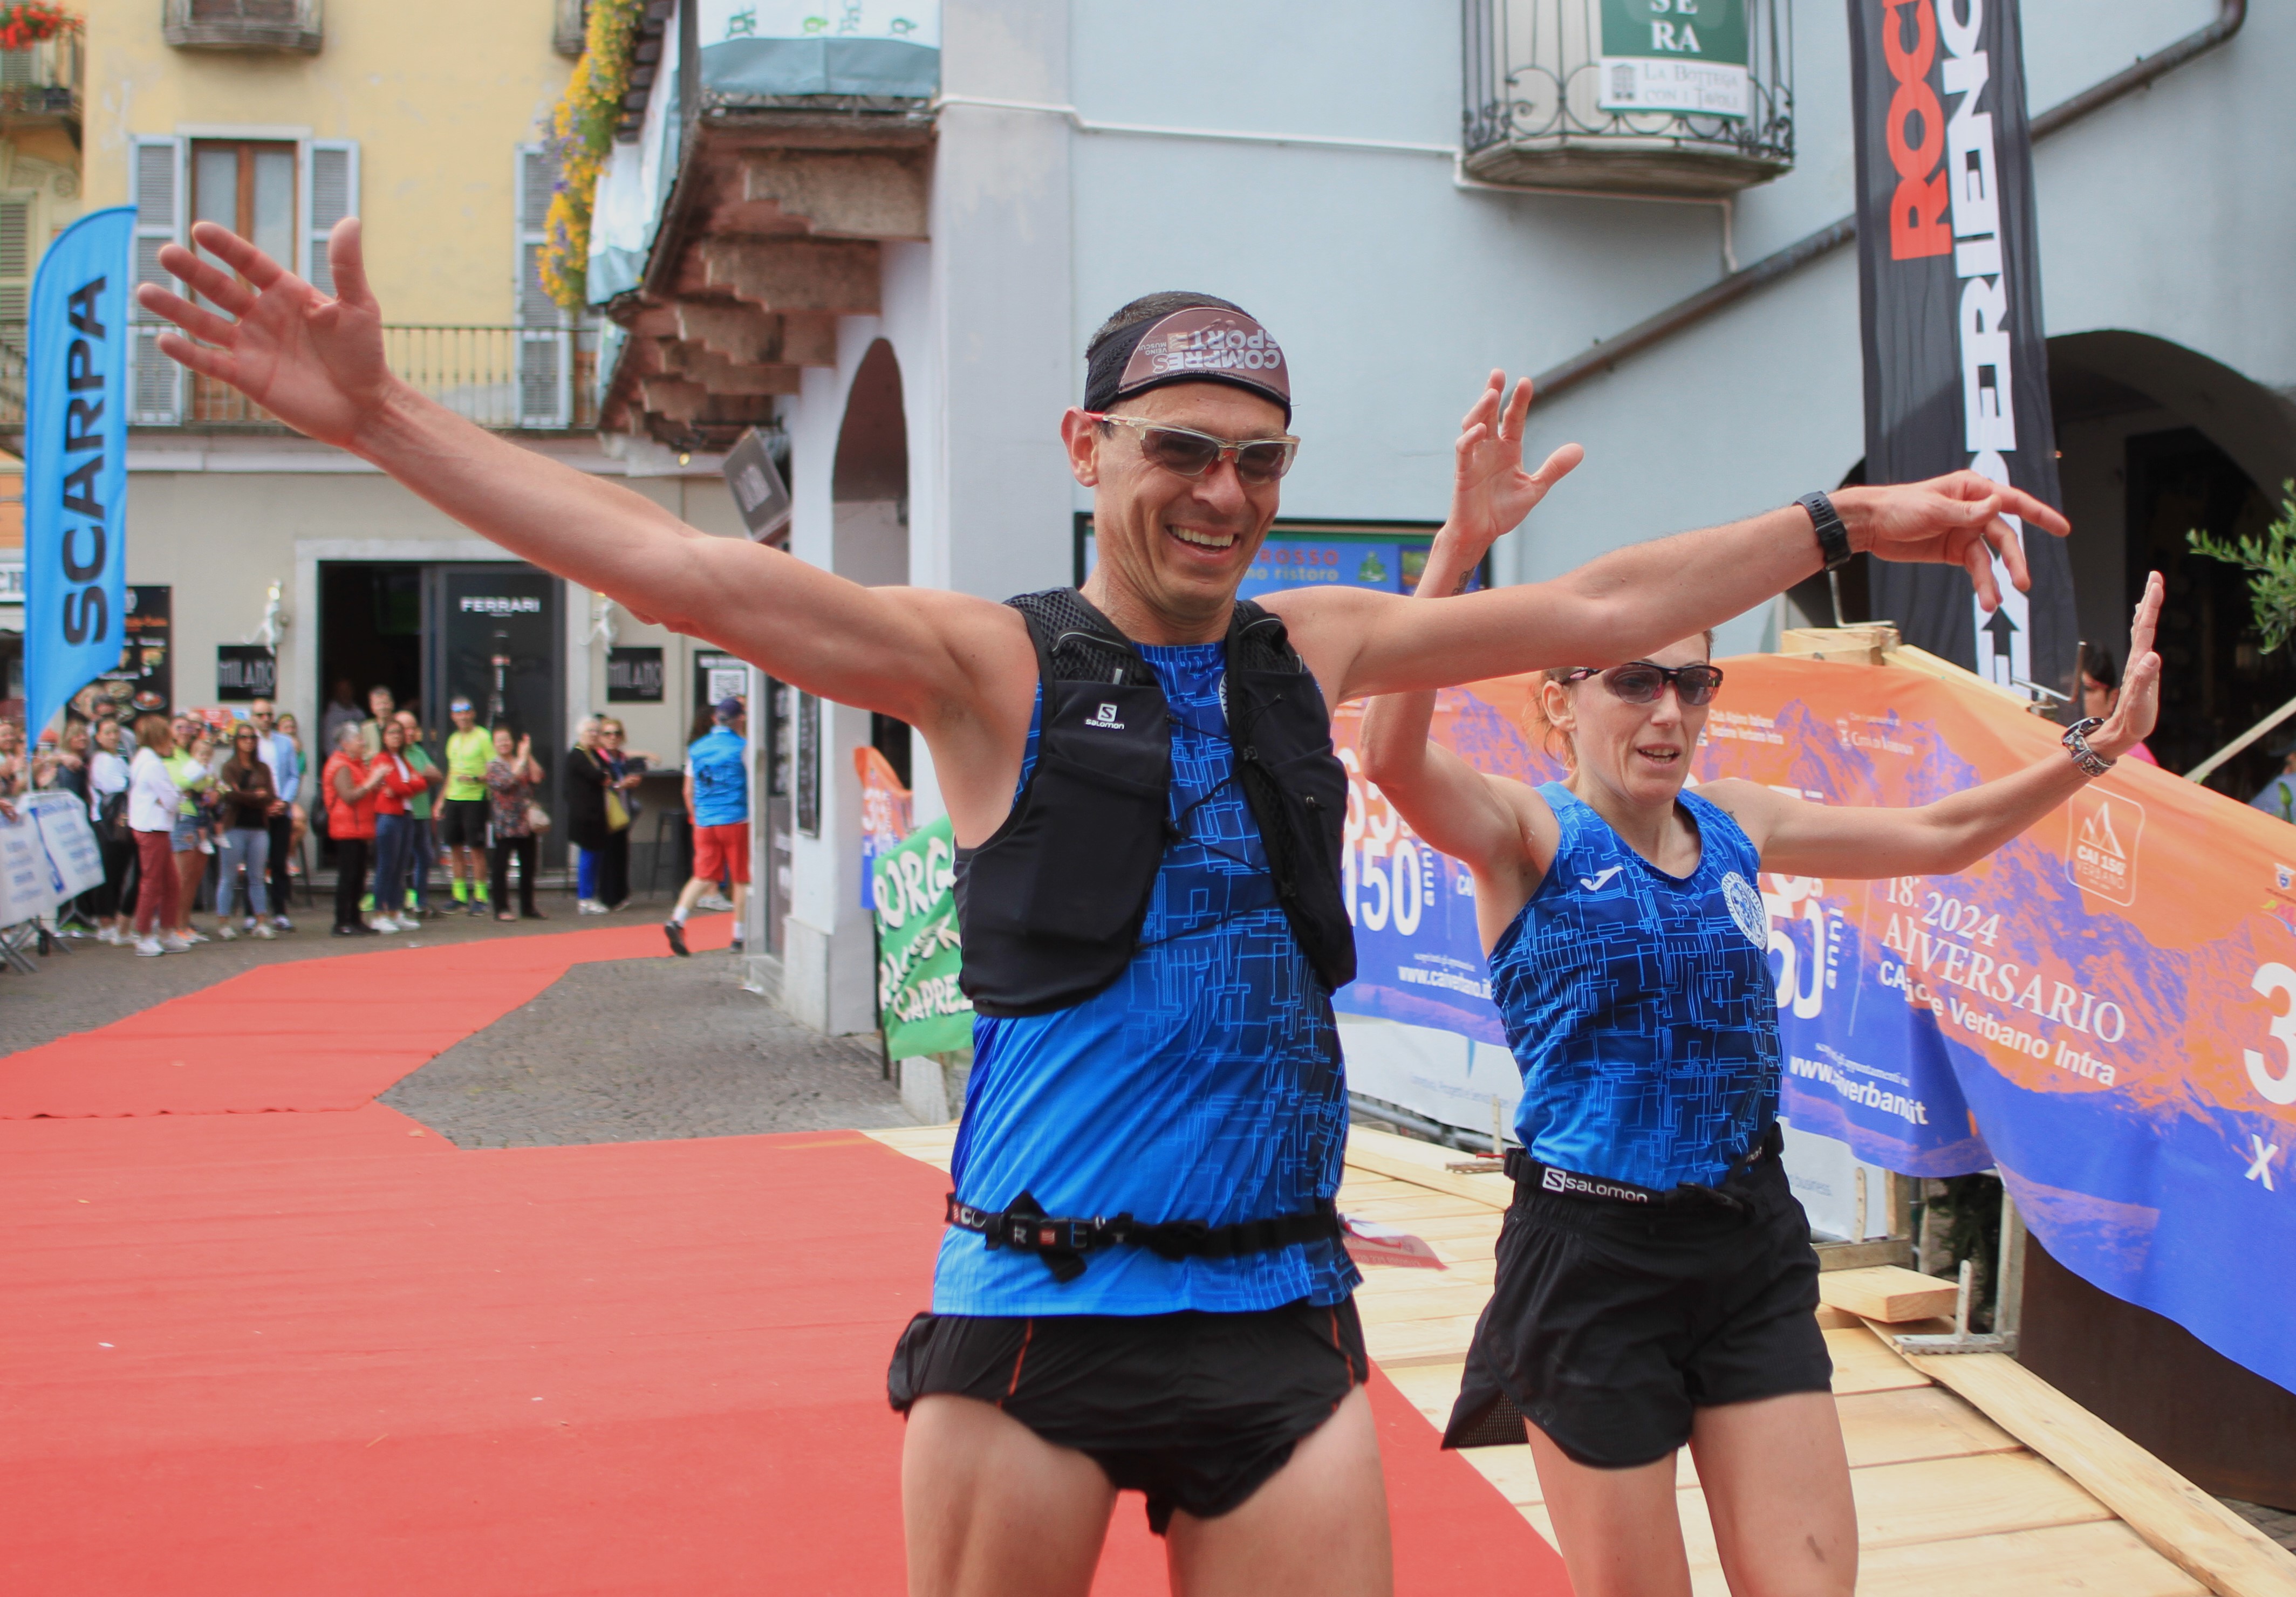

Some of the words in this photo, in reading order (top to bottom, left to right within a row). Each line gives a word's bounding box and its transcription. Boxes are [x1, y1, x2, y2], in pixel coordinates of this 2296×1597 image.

[1651, 20, 1702, 53] RA
[1882, 0, 1952, 260] ROC
[1145, 347, 1167, 355] VEINO
[1152, 350, 1281, 373] COMPRES
[61, 276, 108, 646] SCARPA
[1274, 566, 1340, 582] ristoro
[460, 595, 541, 613] FERRARI
[218, 659, 275, 688] MILANO
[1341, 836, 1422, 936] 150
[1921, 891, 2000, 948] 2024
[1950, 997, 2049, 1061] Verbano
[2054, 1040, 2117, 1089] Intra
